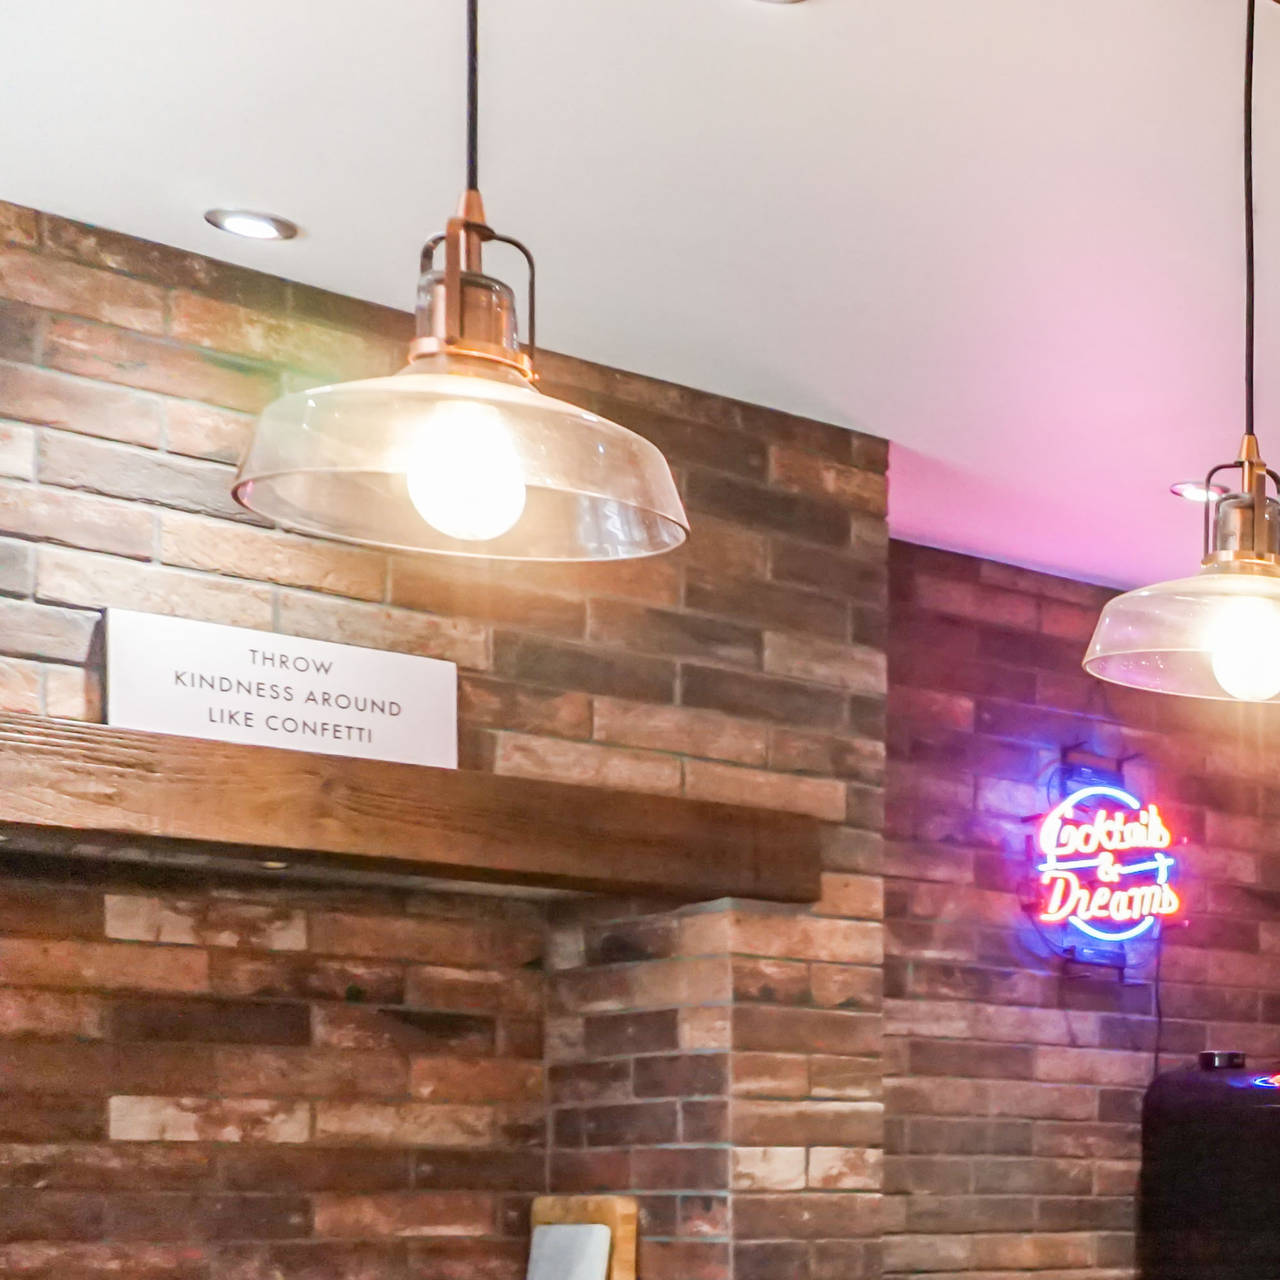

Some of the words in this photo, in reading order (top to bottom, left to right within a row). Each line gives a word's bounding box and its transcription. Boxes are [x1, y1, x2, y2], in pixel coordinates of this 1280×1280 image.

[249, 648, 333, 675] THROW
[174, 670, 295, 702] KINDNESS
[305, 690, 402, 717] AROUND
[209, 707, 254, 728] LIKE
[265, 715, 373, 743] CONFETTI
[1040, 870, 1180, 922] Dreams
